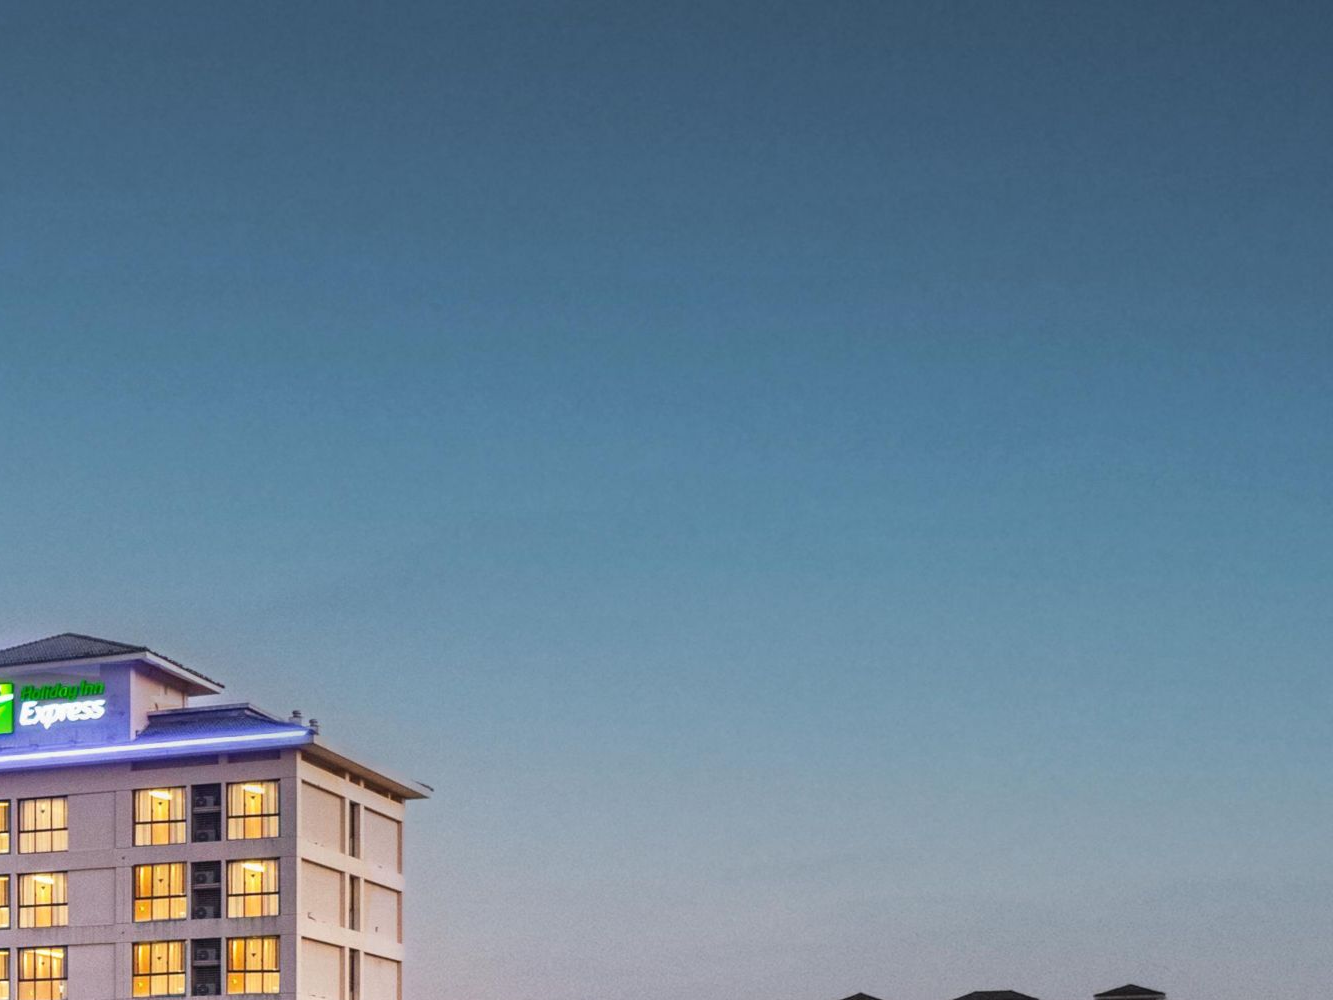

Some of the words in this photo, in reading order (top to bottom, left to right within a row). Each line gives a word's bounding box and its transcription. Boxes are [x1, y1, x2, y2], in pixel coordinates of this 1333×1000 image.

[20, 682, 78, 701] Holiday
[79, 680, 105, 696] Inn
[19, 699, 106, 729] Express
